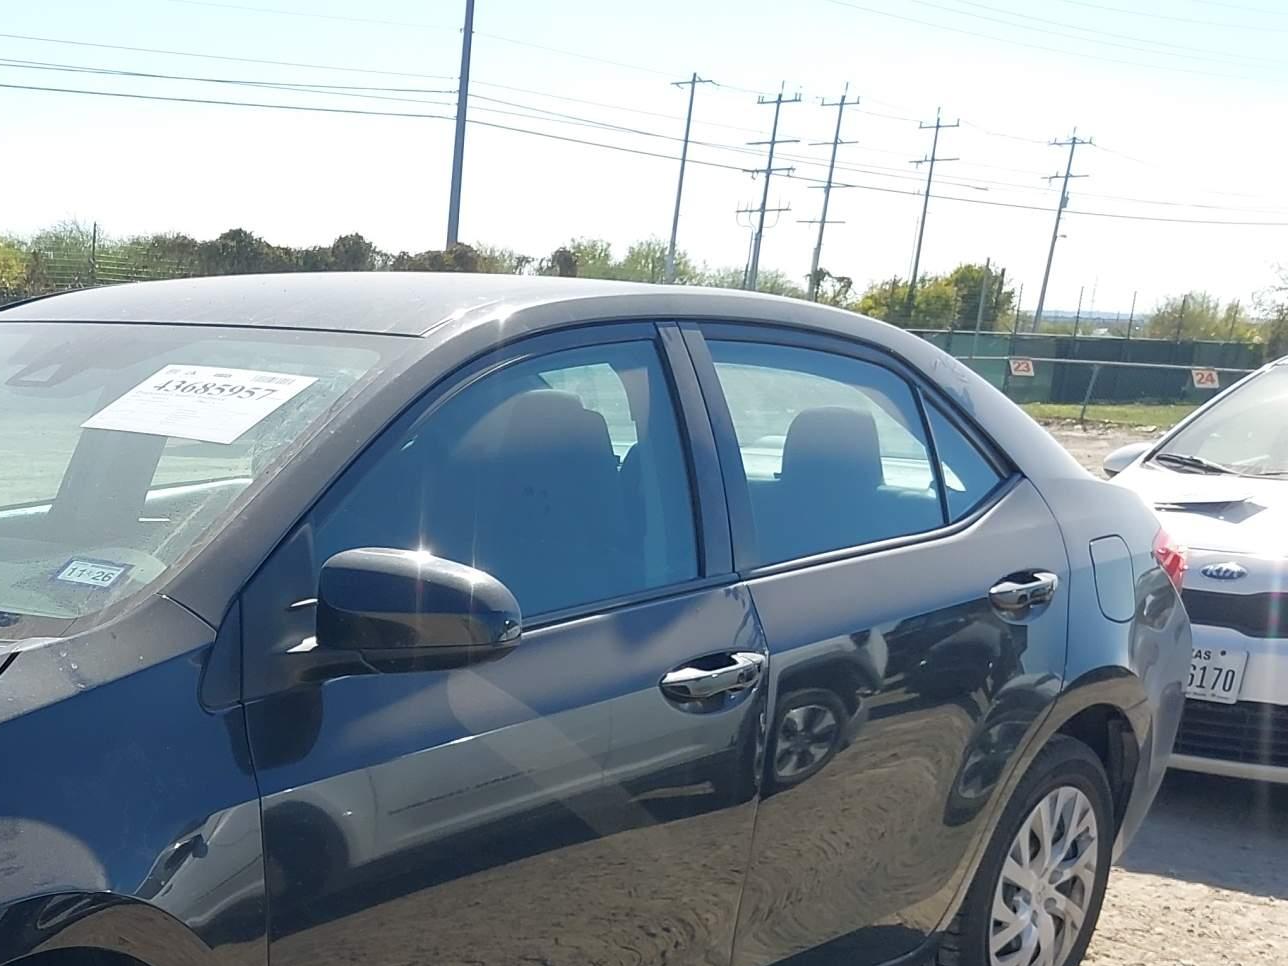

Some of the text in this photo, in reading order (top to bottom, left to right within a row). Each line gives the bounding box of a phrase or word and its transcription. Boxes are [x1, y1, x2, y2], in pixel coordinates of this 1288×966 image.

[1012, 358, 1031, 373] 23
[1195, 371, 1216, 384] 24
[153, 379, 279, 401] 43685957
[67, 567, 114, 582] 11 26
